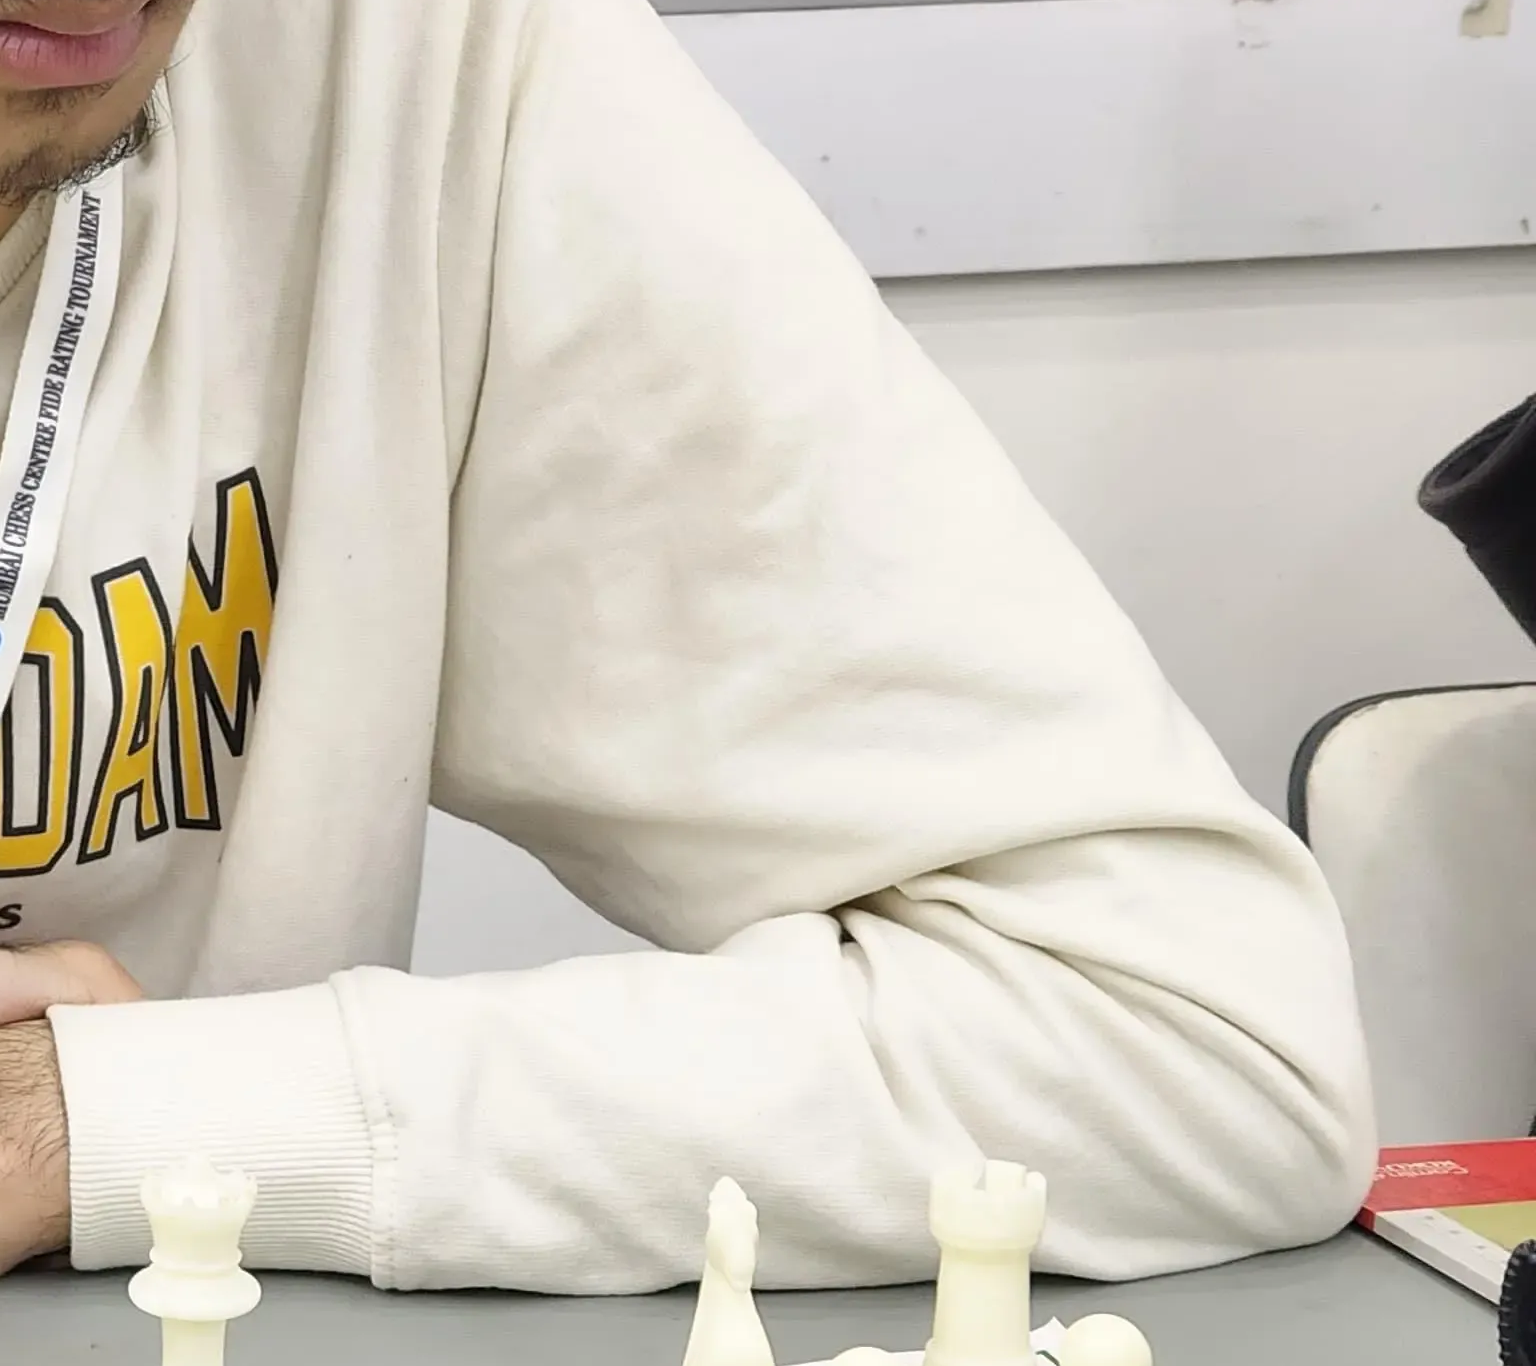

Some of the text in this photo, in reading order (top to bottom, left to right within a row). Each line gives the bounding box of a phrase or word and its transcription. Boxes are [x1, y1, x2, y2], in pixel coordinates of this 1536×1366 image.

[68, 191, 103, 311] TOURNAMENT
[47, 310, 86, 380] RATING
[38, 376, 65, 423] FIDE
[21, 421, 57, 492] CENTRE
[2, 492, 36, 548] CHESS
